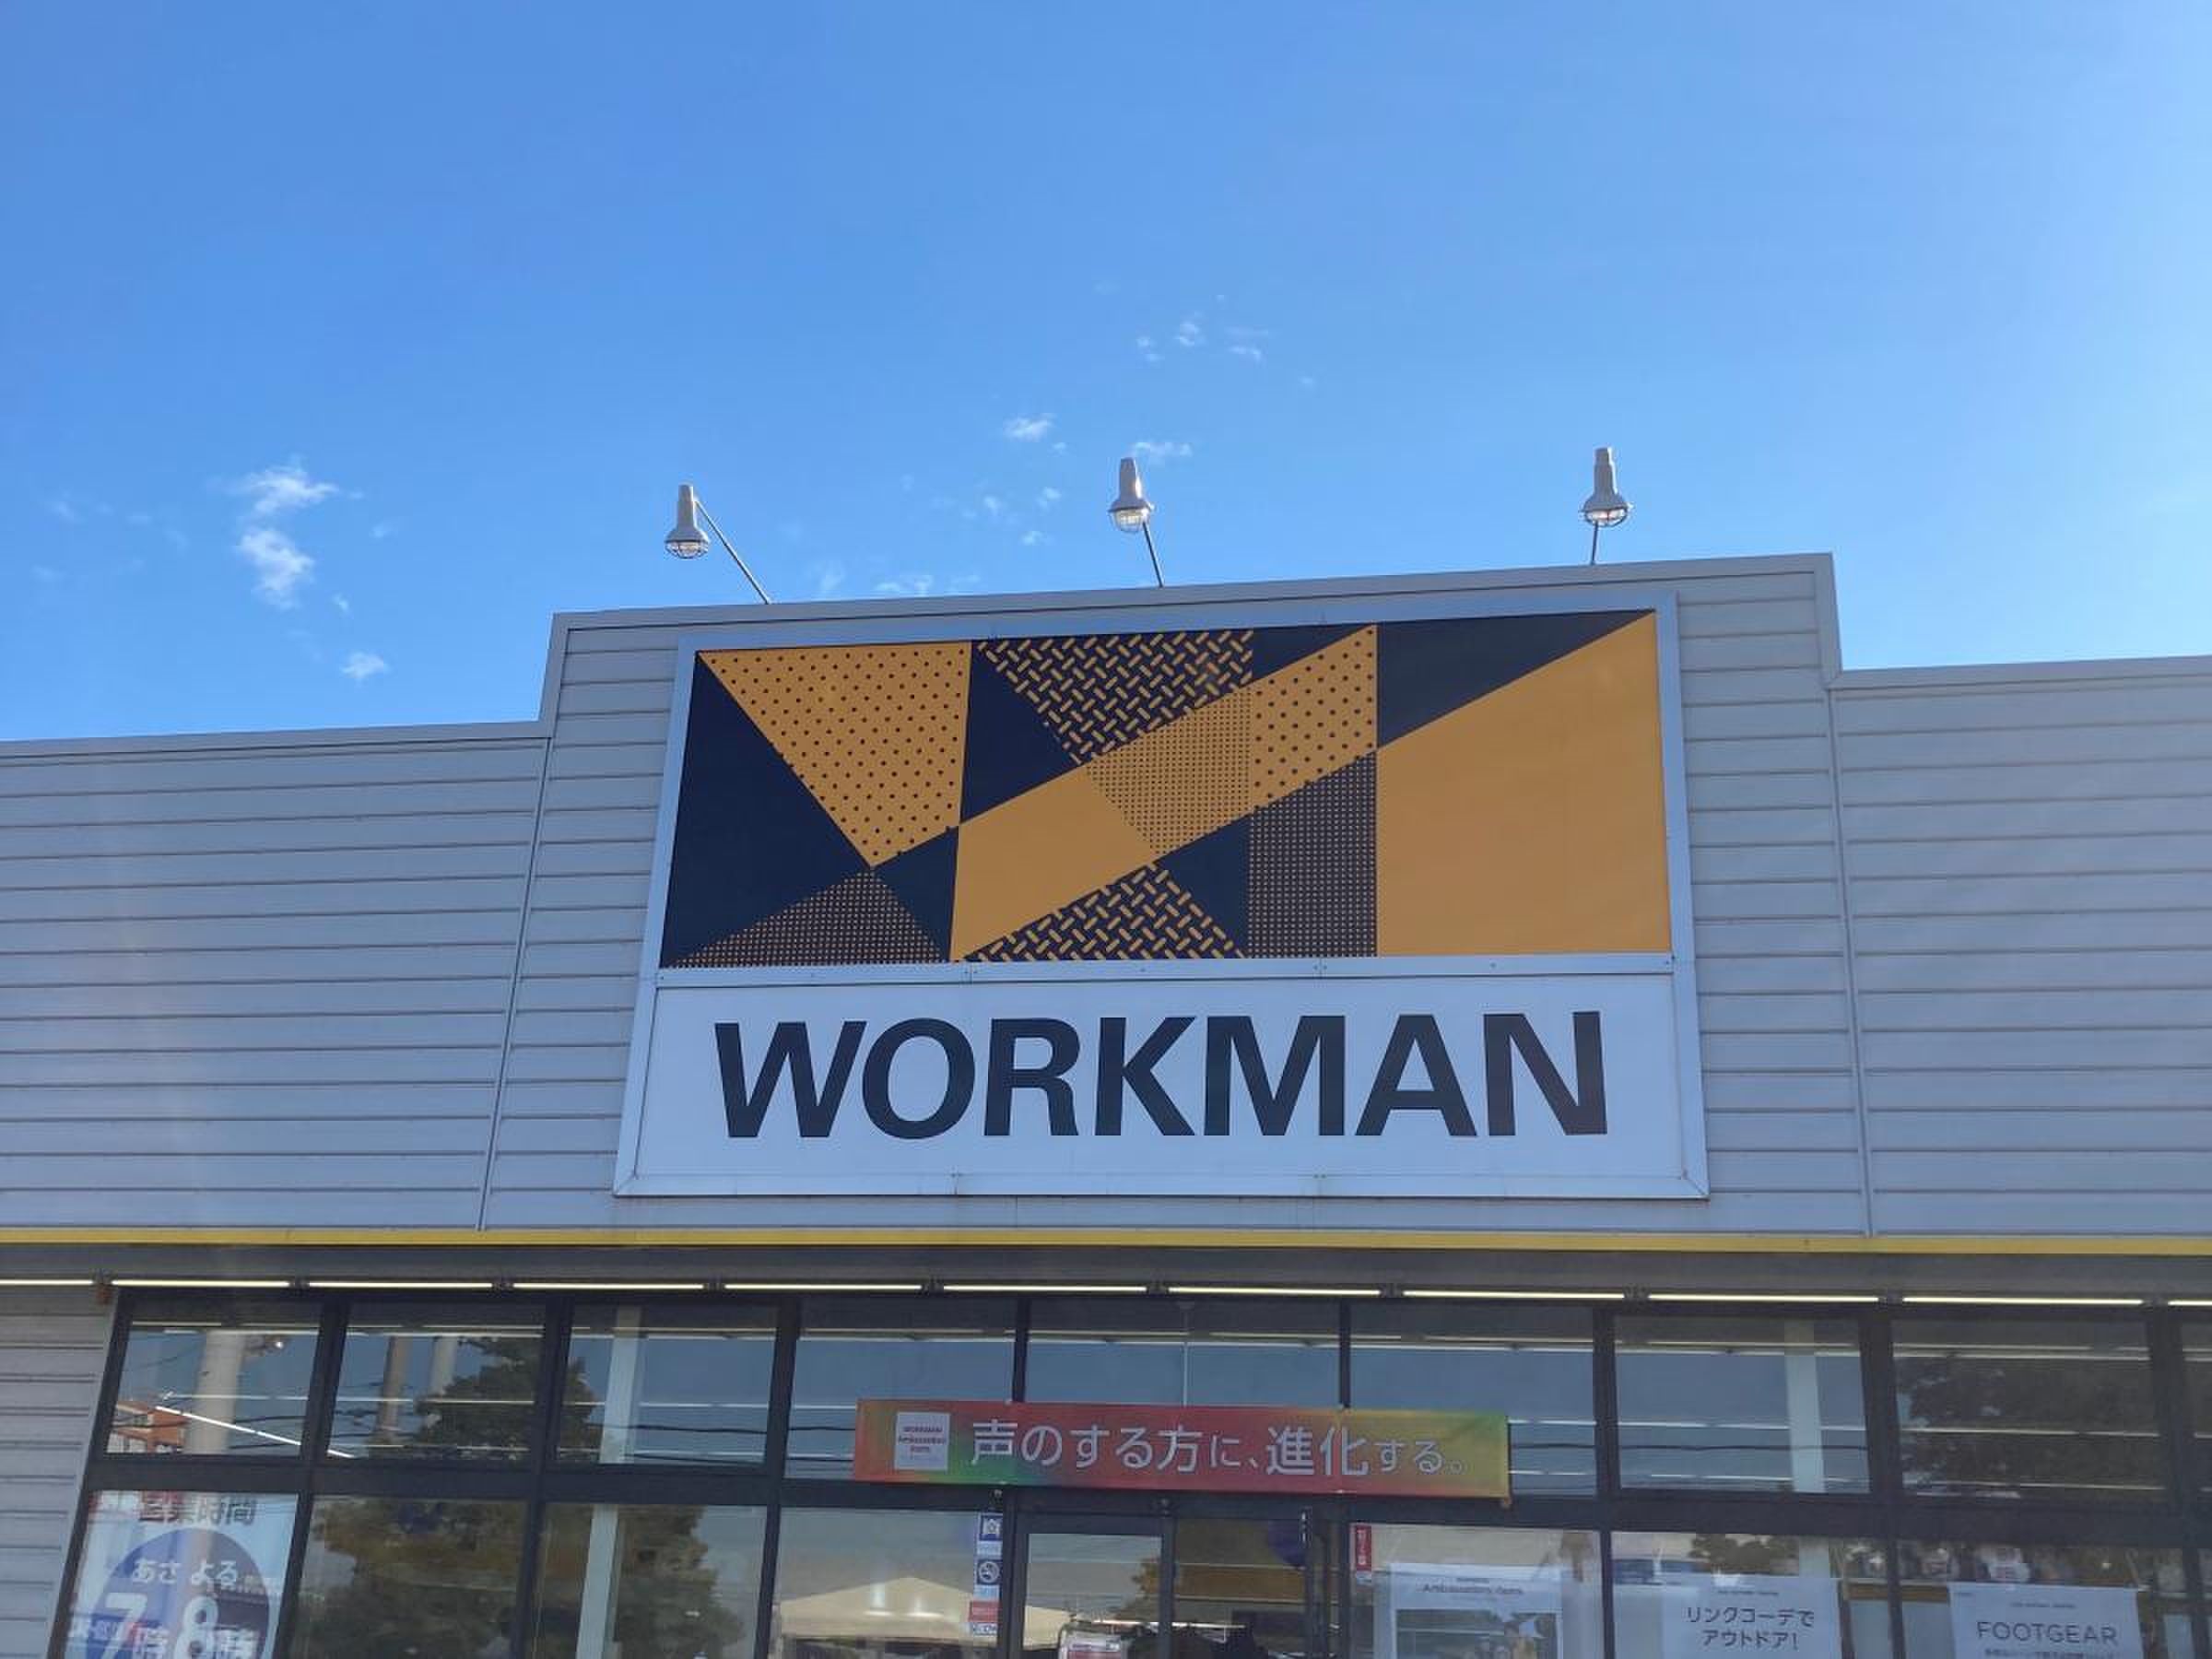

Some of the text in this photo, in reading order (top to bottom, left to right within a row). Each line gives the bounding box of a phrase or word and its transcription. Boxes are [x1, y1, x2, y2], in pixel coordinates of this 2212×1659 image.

[714, 1011, 1608, 1139] WORKMAN
[971, 1419, 1465, 1476] 声のする方に、進化する。
[133, 1558, 238, 1589] あさ よる
[1976, 1621, 2118, 1645] FOOTGEAR
